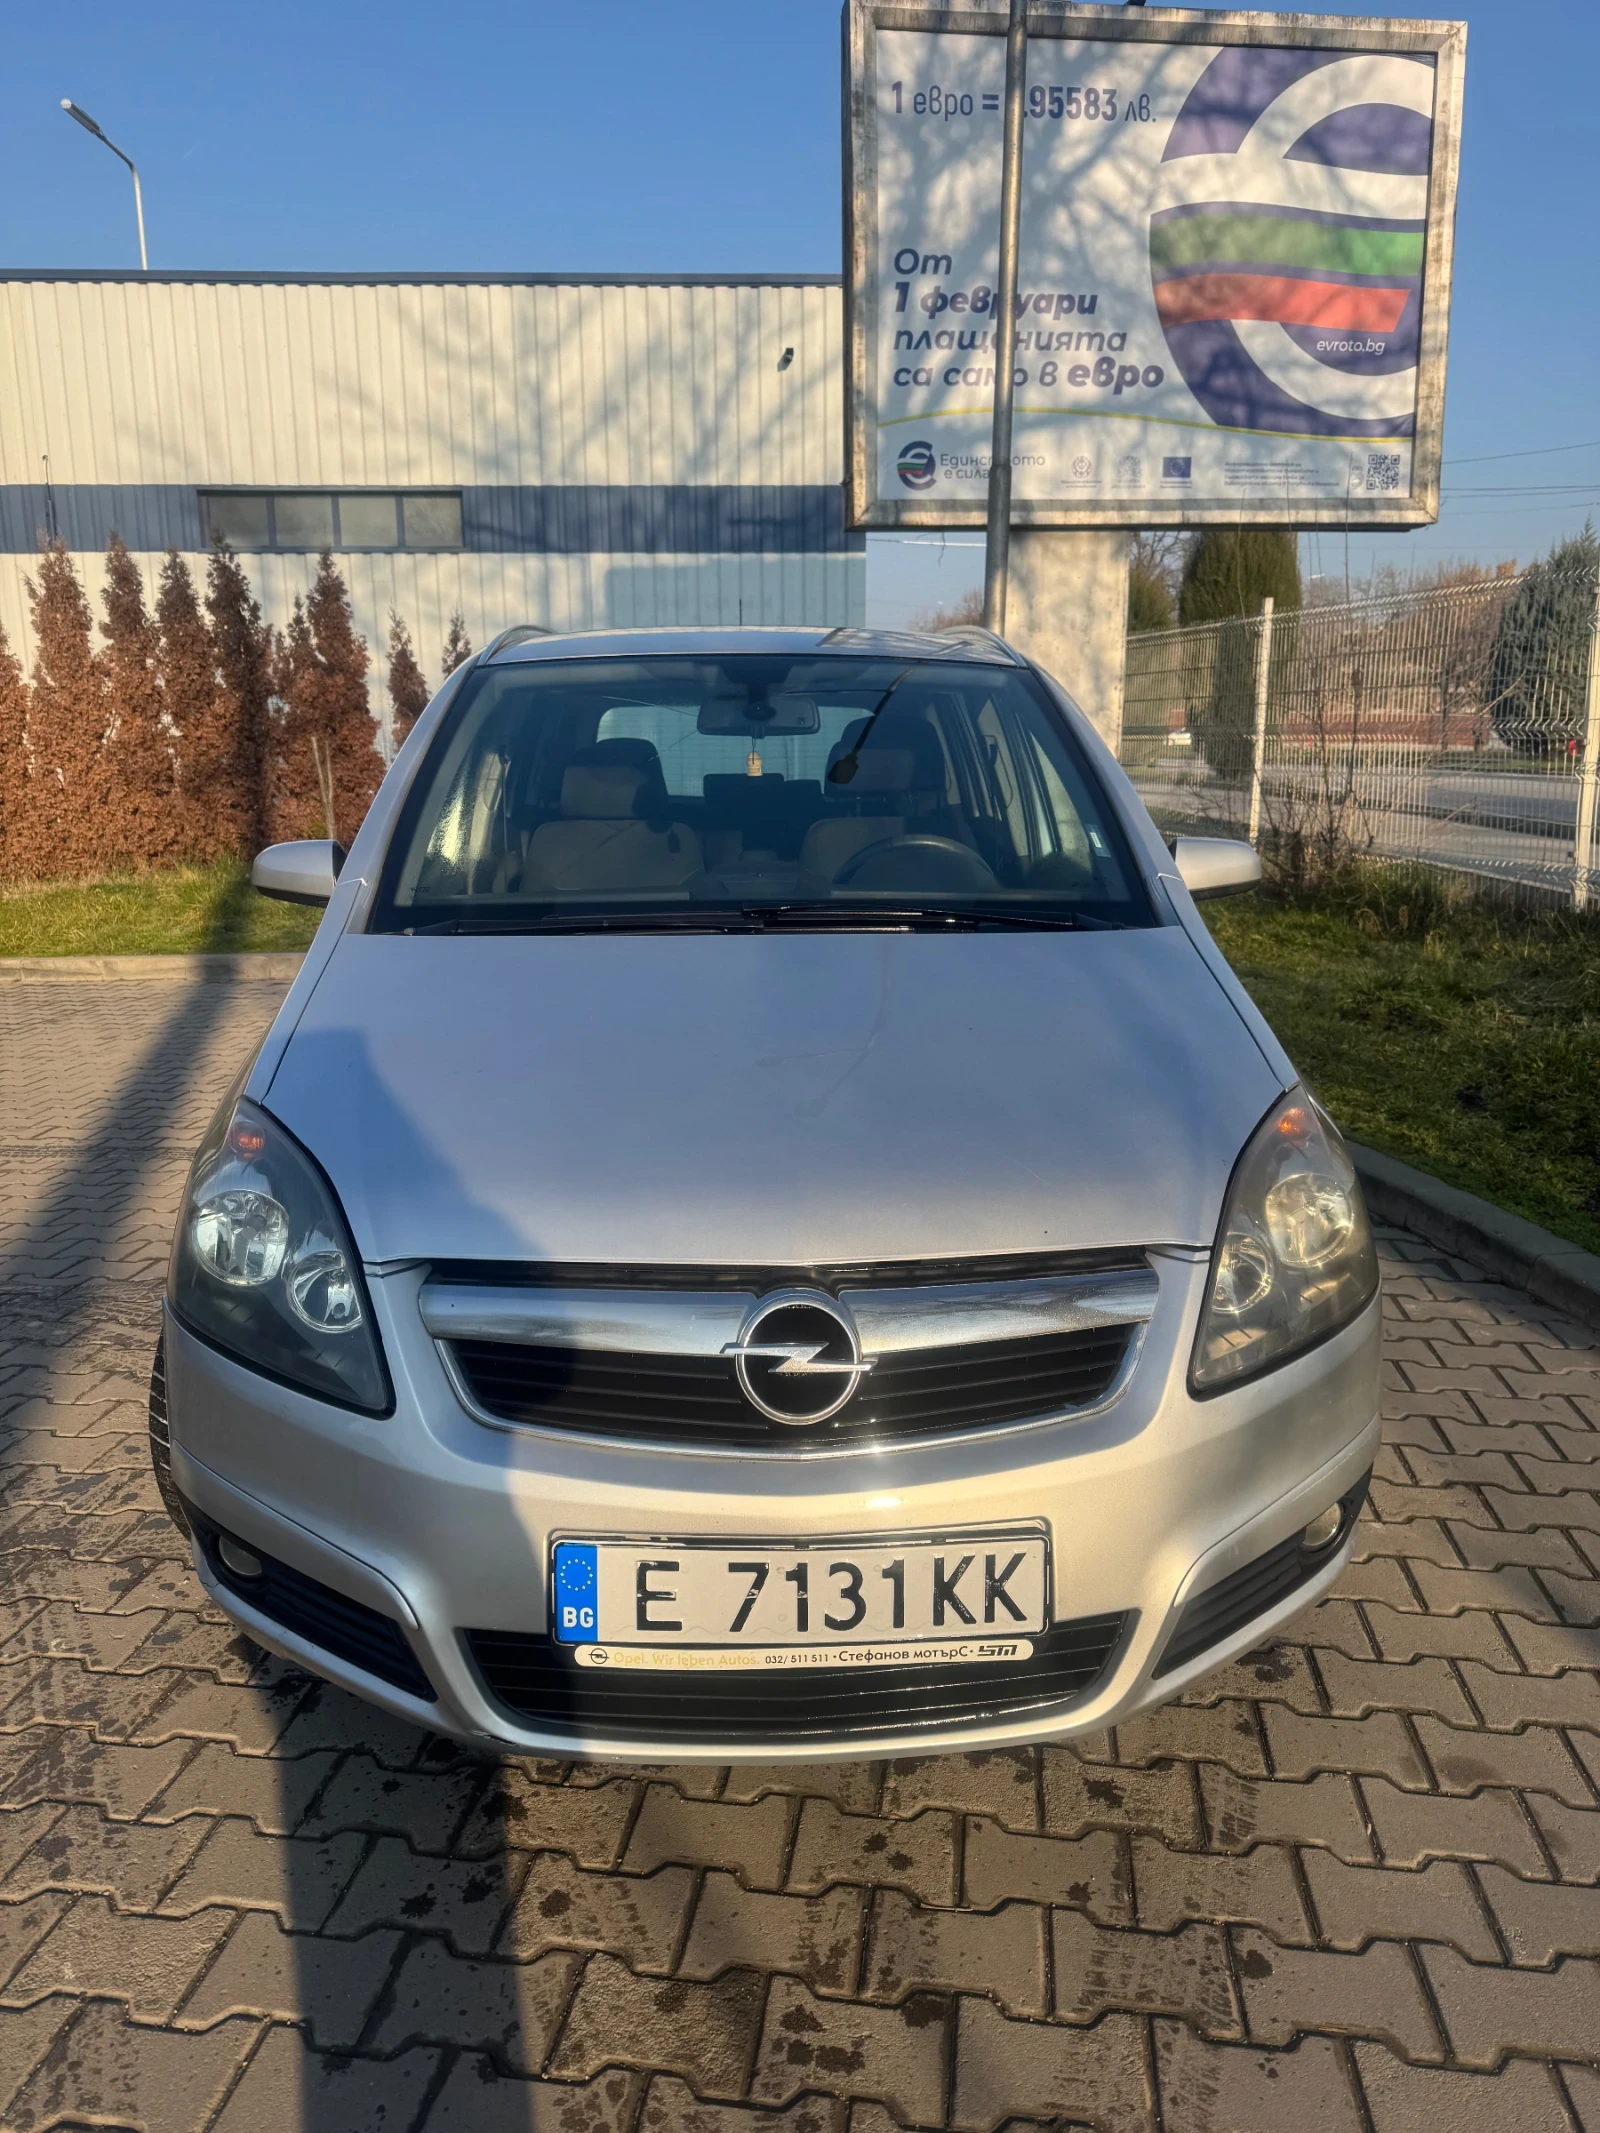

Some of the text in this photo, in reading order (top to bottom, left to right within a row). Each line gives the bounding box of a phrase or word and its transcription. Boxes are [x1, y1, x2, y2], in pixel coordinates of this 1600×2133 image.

[891, 80, 1157, 123] 1 евро = .95583 лв.
[893, 248, 953, 276] От
[895, 282, 910, 313] 1
[893, 329, 1128, 354] плащнията
[1316, 338, 1386, 356] evroto.bg
[893, 366, 934, 387] са
[1038, 361, 1059, 387] в
[1067, 356, 1165, 396] евро
[944, 470, 953, 479] е
[636, 1560, 683, 1632] E
[562, 1606, 594, 1630] BG
[613, 1652, 648, 1666] Opel.
[652, 1653, 674, 1665] Wir
[677, 1652, 715, 1667] leben
[717, 1653, 760, 1666] Autos.
[765, 1655, 787, 1664] 032/
[790, 1654, 809, 1663] 511
[811, 1654, 829, 1662] 511
